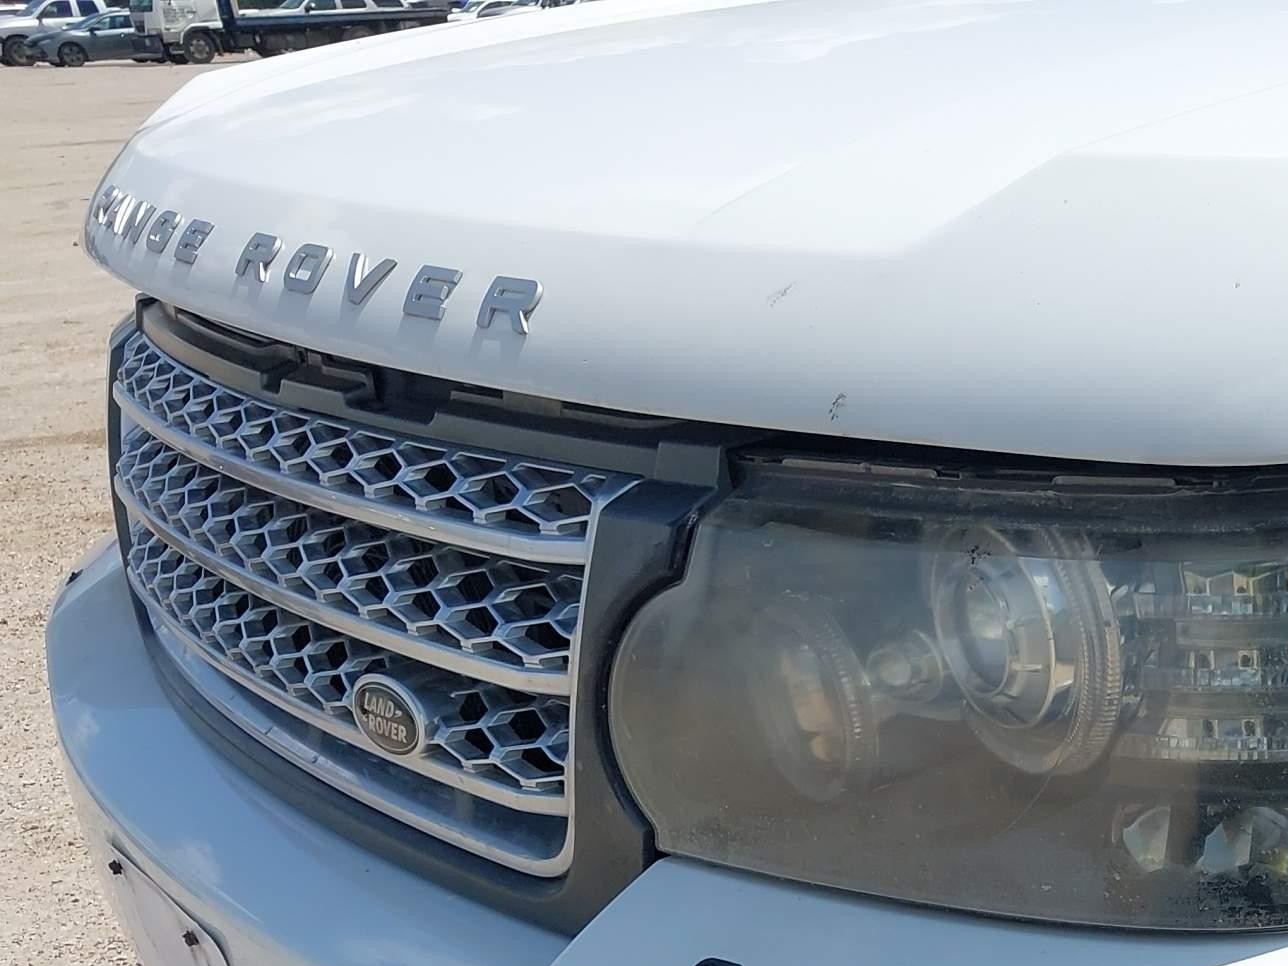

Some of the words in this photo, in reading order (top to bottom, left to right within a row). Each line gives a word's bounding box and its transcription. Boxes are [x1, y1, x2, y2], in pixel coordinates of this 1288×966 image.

[93, 183, 216, 265] RANGE
[234, 232, 544, 335] ROVER
[364, 691, 395, 719] LAND
[368, 713, 408, 744] ROVER
